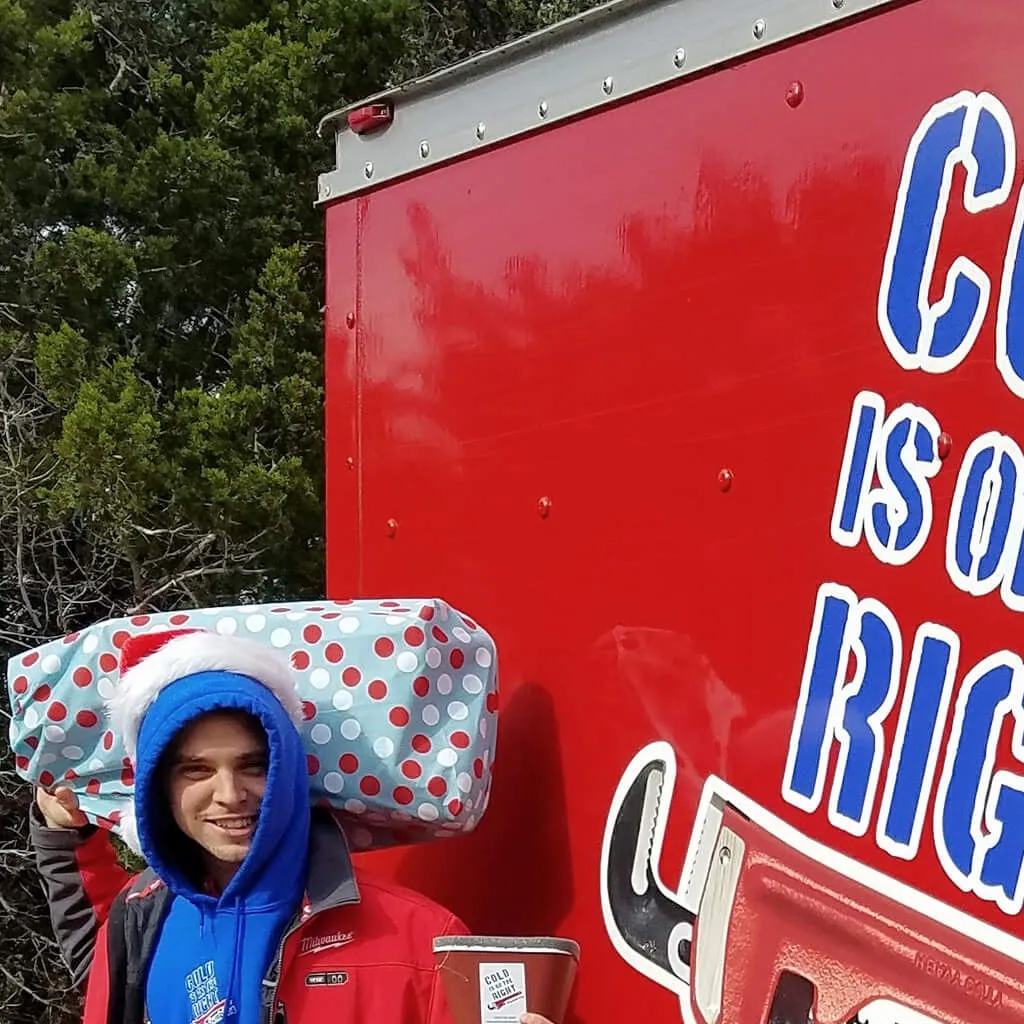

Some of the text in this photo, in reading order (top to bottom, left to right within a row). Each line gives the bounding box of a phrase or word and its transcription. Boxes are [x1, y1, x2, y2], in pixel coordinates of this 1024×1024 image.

[831, 390, 941, 564] IS
[484, 968, 510, 985] COLD
[491, 984, 516, 1001] RIGHT
